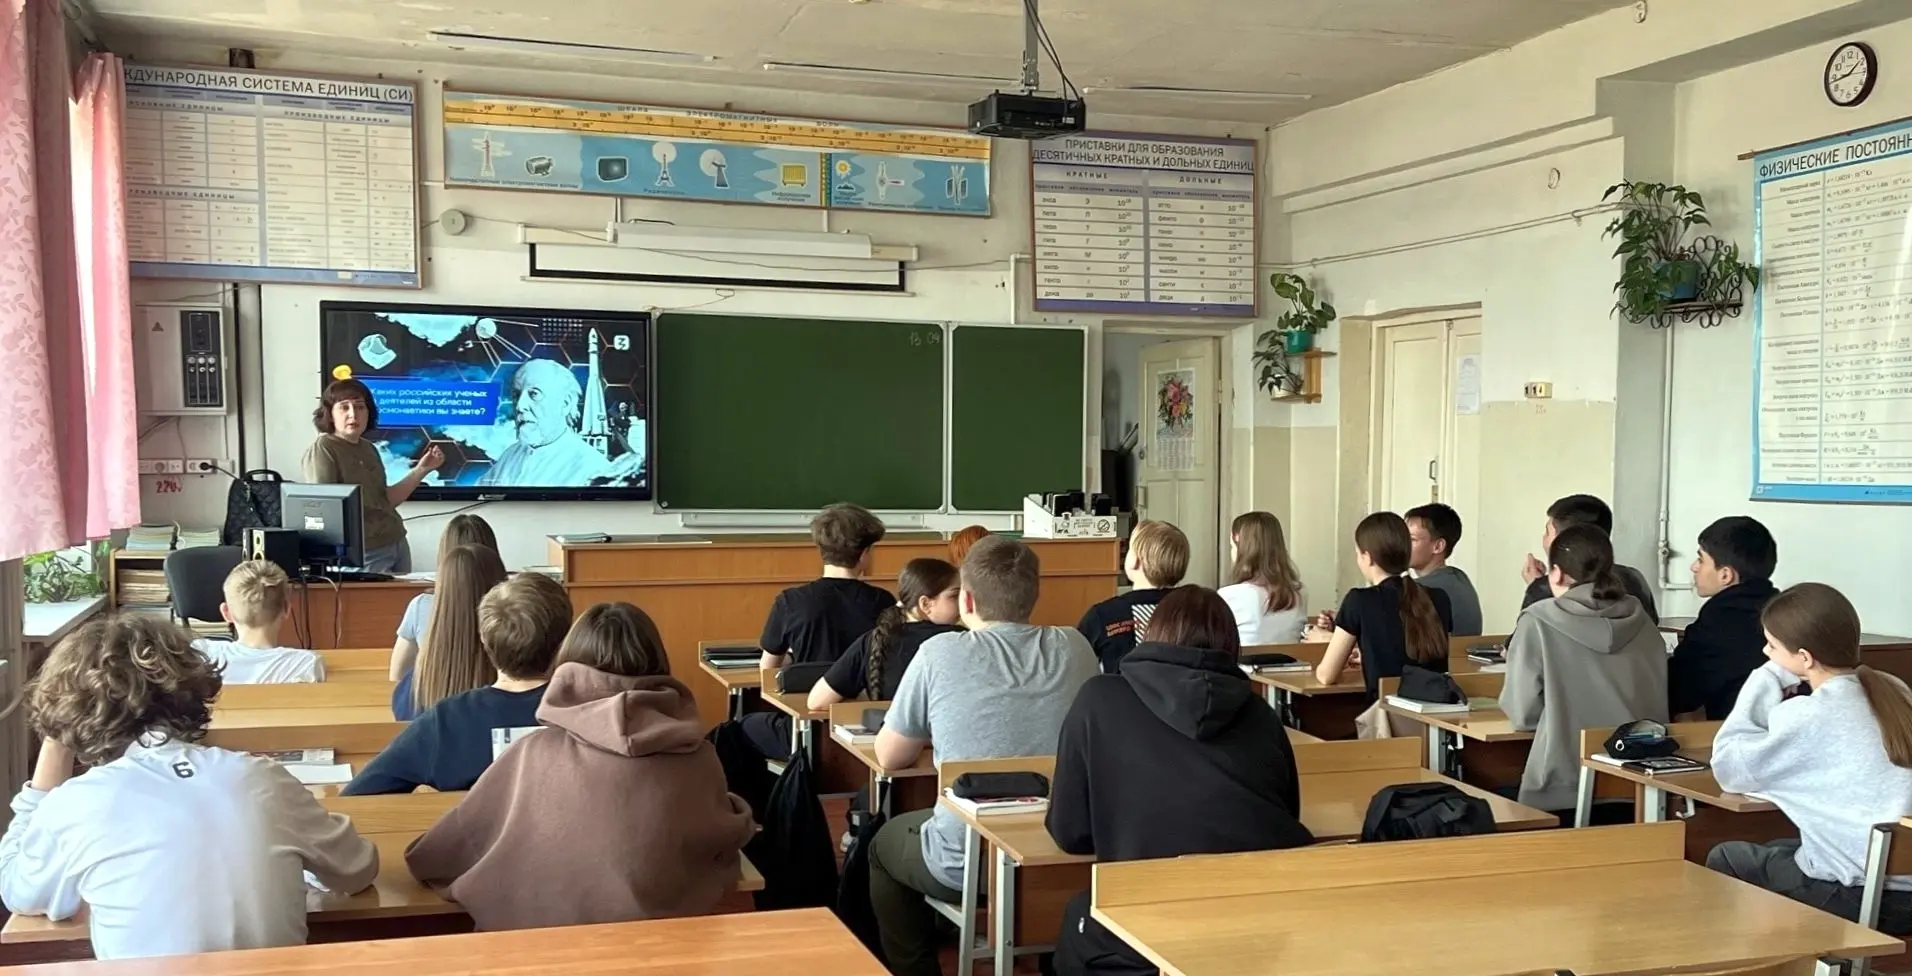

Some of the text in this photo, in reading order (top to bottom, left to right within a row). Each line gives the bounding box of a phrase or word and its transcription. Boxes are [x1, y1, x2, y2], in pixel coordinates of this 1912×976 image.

[242, 77, 314, 94] СИСТЕМА
[318, 83, 381, 100] ЕДИНИЦ
[384, 88, 413, 103] (СИ)
[1066, 139, 1224, 157] ПРИСТАВКИ ДЛЯ ОБРАЗОВАНИЯ
[1033, 150, 1254, 173] ДЕСЯТИЧНЫХ КРАТНЫХ И ДОЛЬНЫХ ЕДИНИЦ
[1760, 148, 1840, 178] ФИЗИЧЕСКИЕ
[1066, 170, 1108, 179] КРАТНЫЕ
[1179, 176, 1222, 184] ДОЛЬНЫЕ
[379, 397, 422, 405] деятелей
[436, 398, 472, 406] области
[399, 388, 452, 397] российских
[455, 390, 488, 398] ученых
[172, 761, 194, 778] 6
